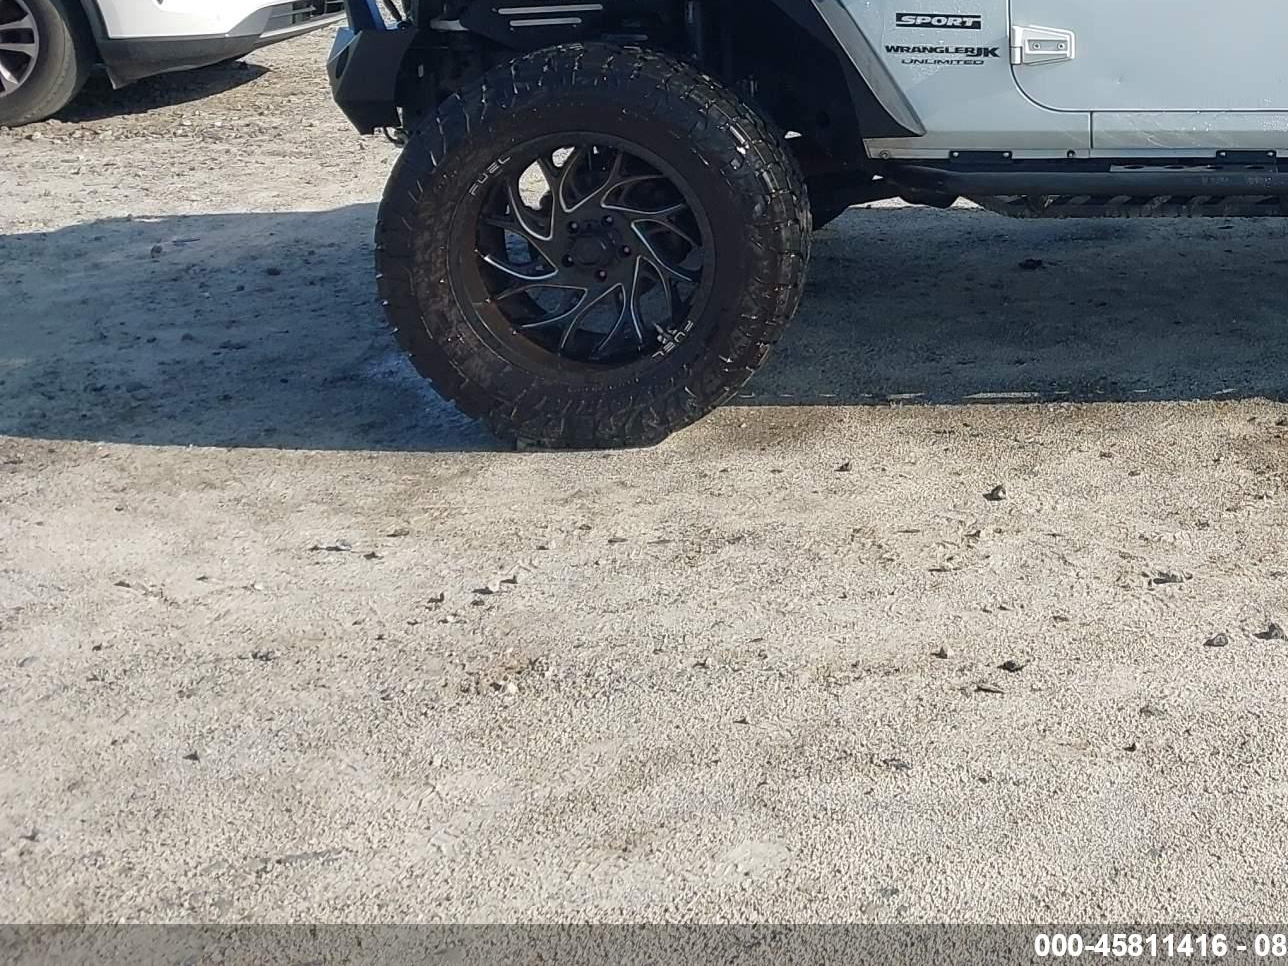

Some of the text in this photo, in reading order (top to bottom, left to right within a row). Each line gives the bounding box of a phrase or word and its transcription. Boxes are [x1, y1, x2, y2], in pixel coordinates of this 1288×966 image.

[898, 15, 981, 27] SPORT
[901, 58, 985, 66] UNLIMITED
[469, 156, 511, 196] FUEL
[651, 320, 694, 358] FUEL
